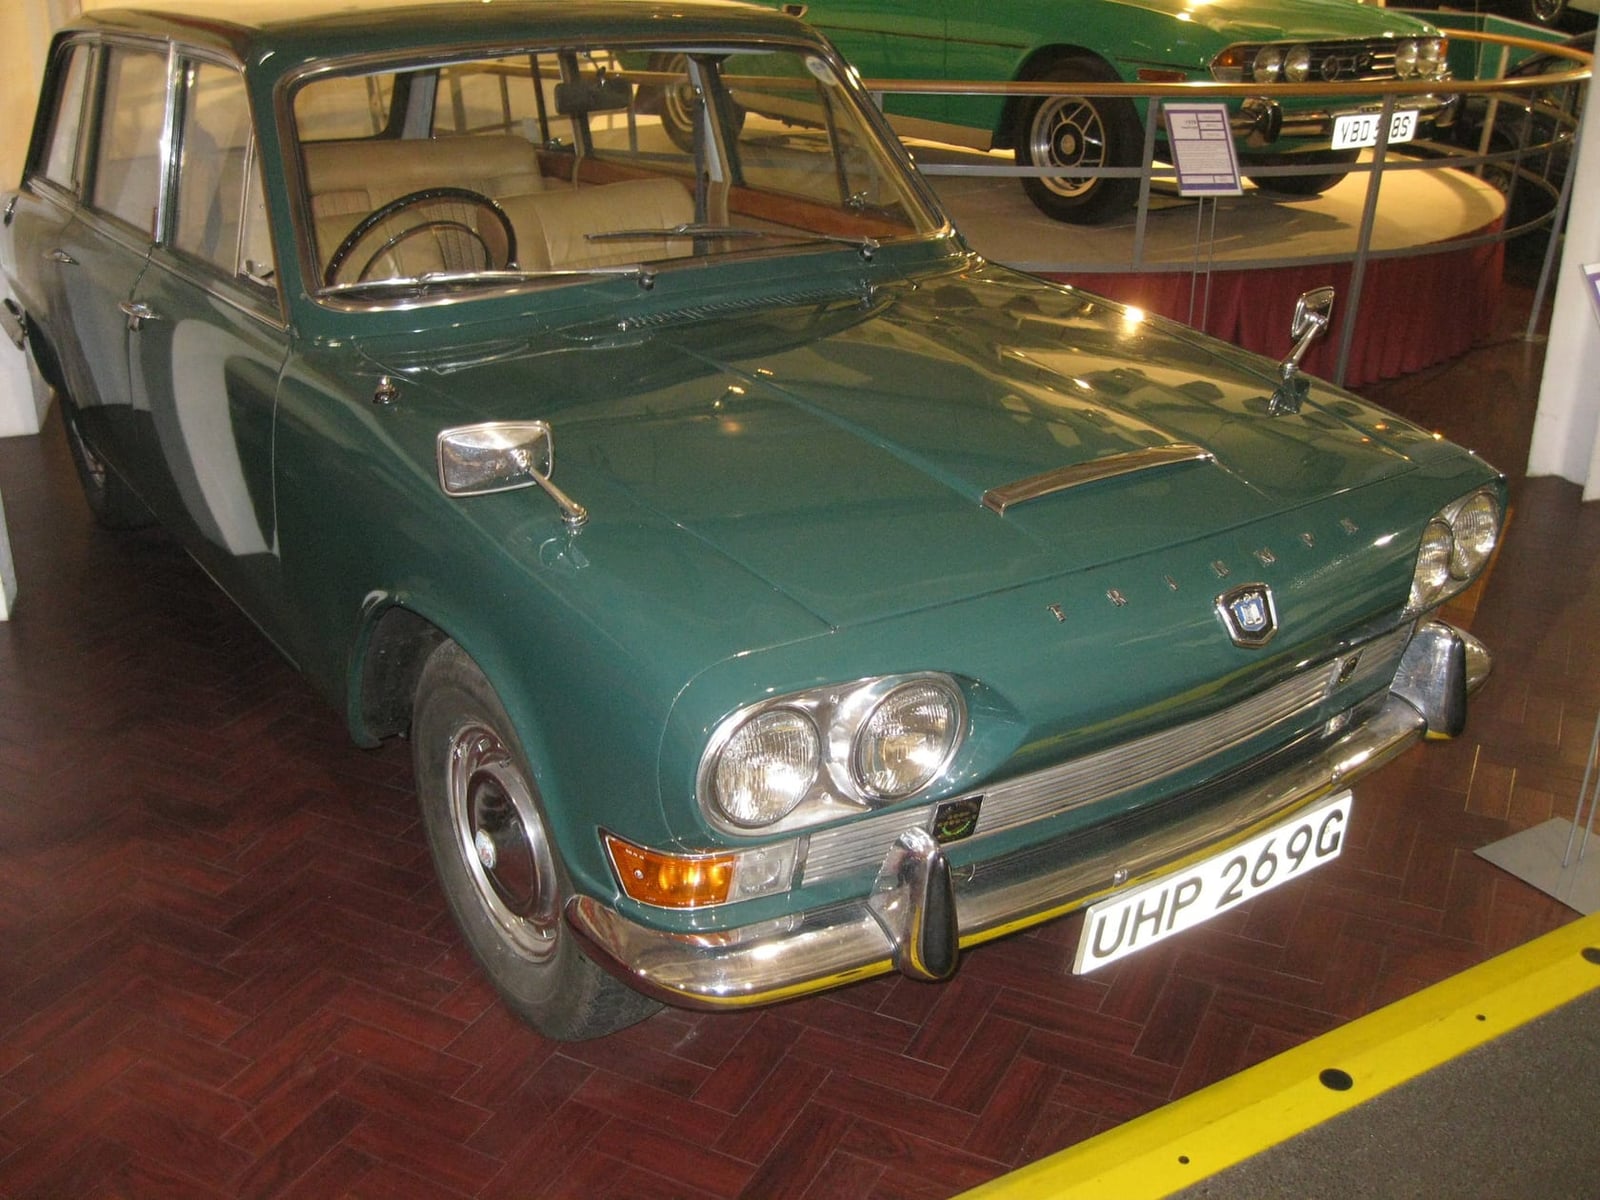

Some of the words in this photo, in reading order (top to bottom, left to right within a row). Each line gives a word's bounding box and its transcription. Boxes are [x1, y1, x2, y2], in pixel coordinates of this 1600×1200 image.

[1373, 116, 1410, 140] 8S
[1047, 517, 1360, 623] TRIUMPH
[1092, 877, 1203, 958] UHP
[1215, 808, 1344, 910] 269G
